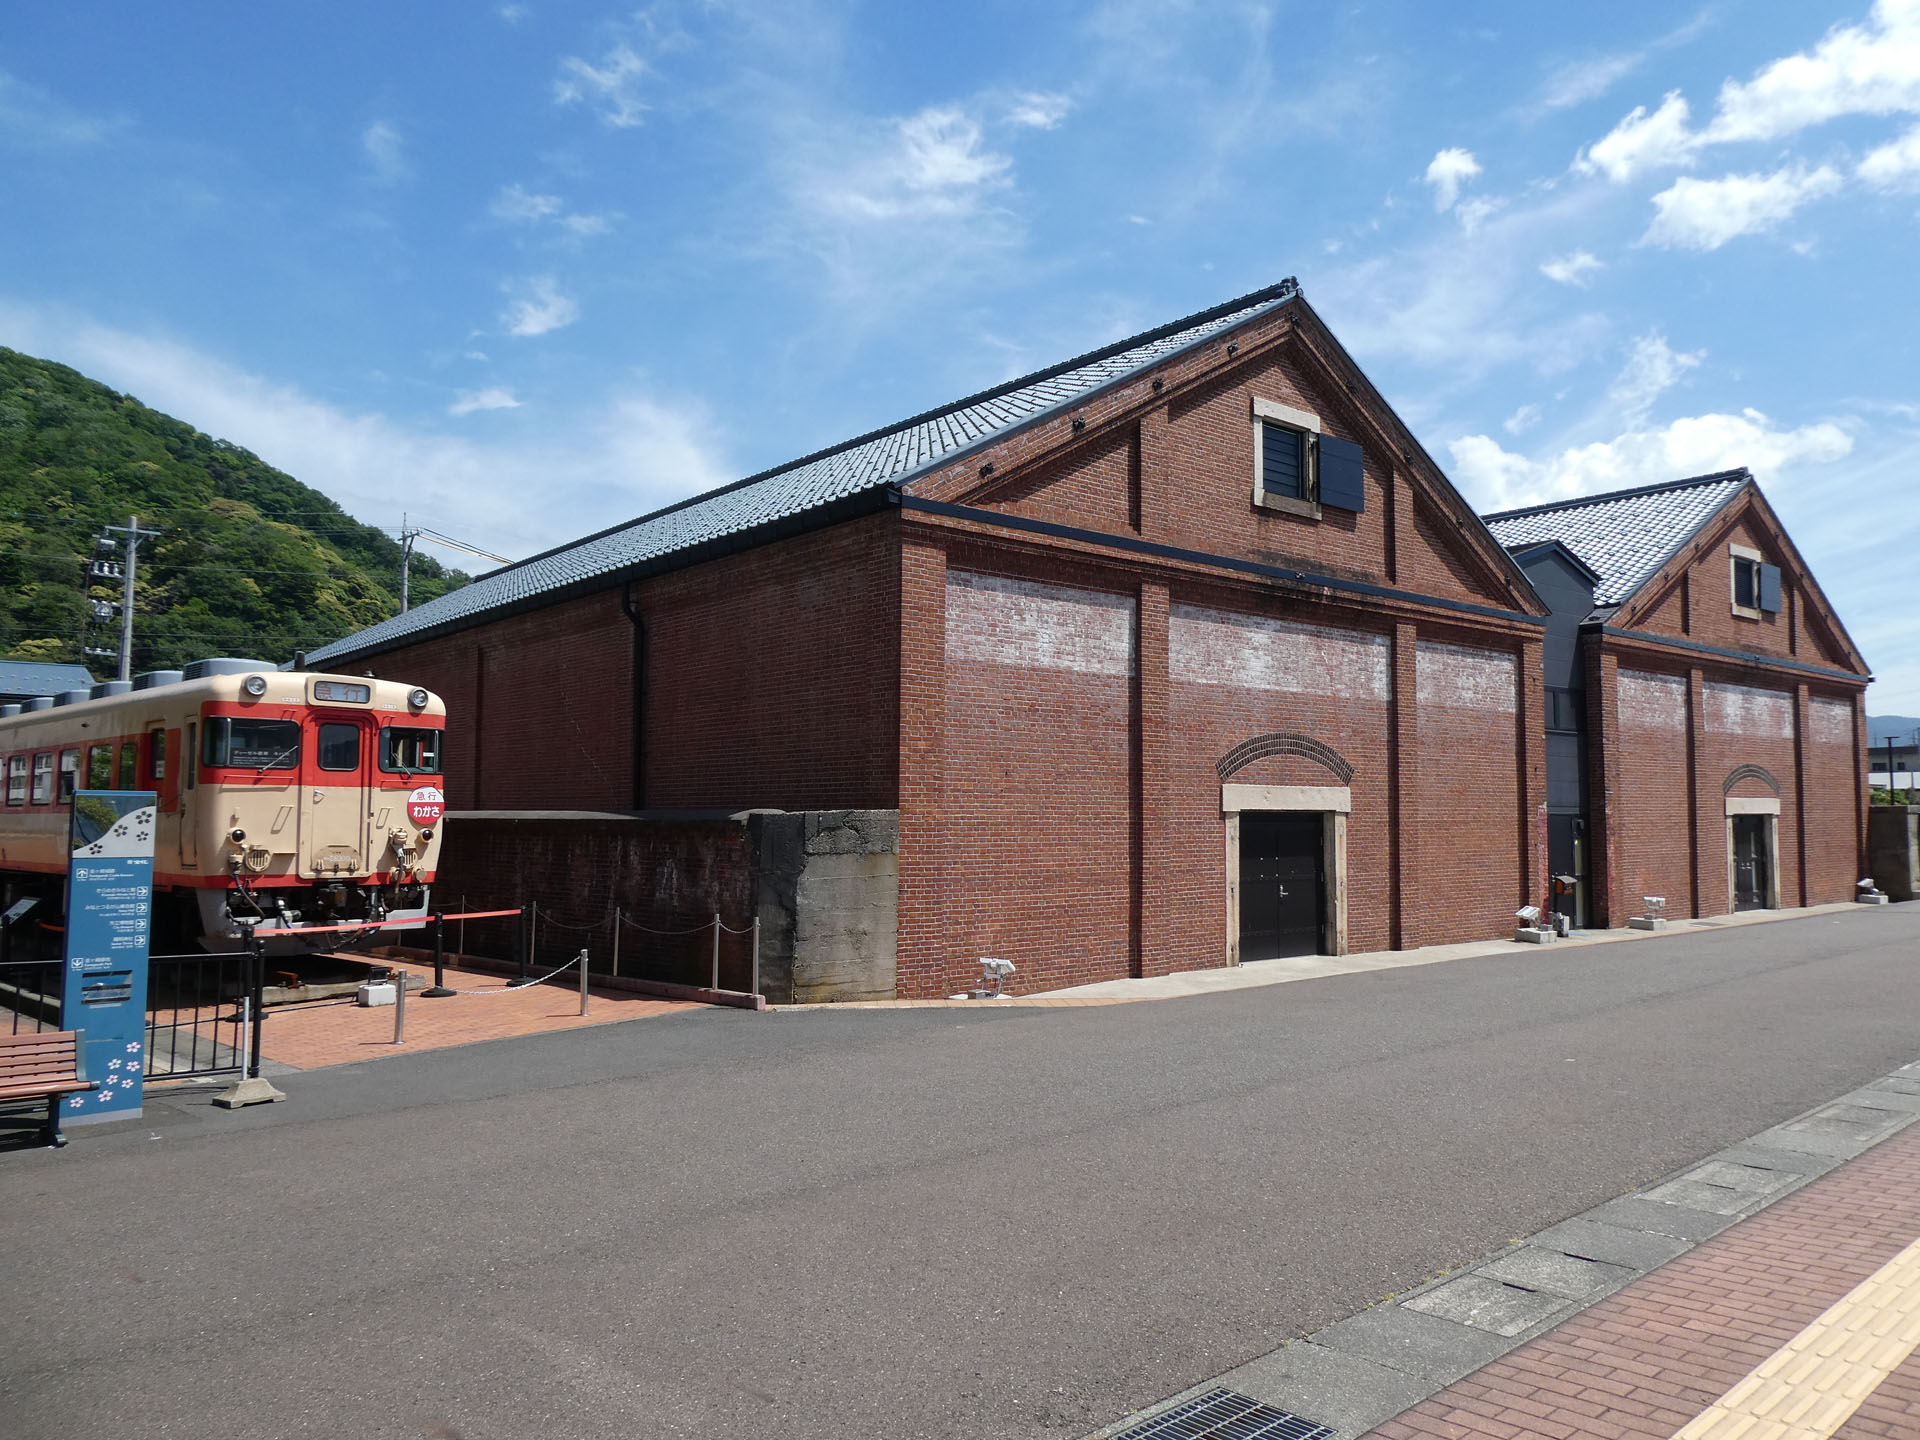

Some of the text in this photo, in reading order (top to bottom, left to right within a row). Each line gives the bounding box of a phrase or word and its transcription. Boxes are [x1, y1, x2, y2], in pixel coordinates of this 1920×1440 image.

[416, 791, 437, 801] 急行
[413, 805, 440, 818] わかさ
